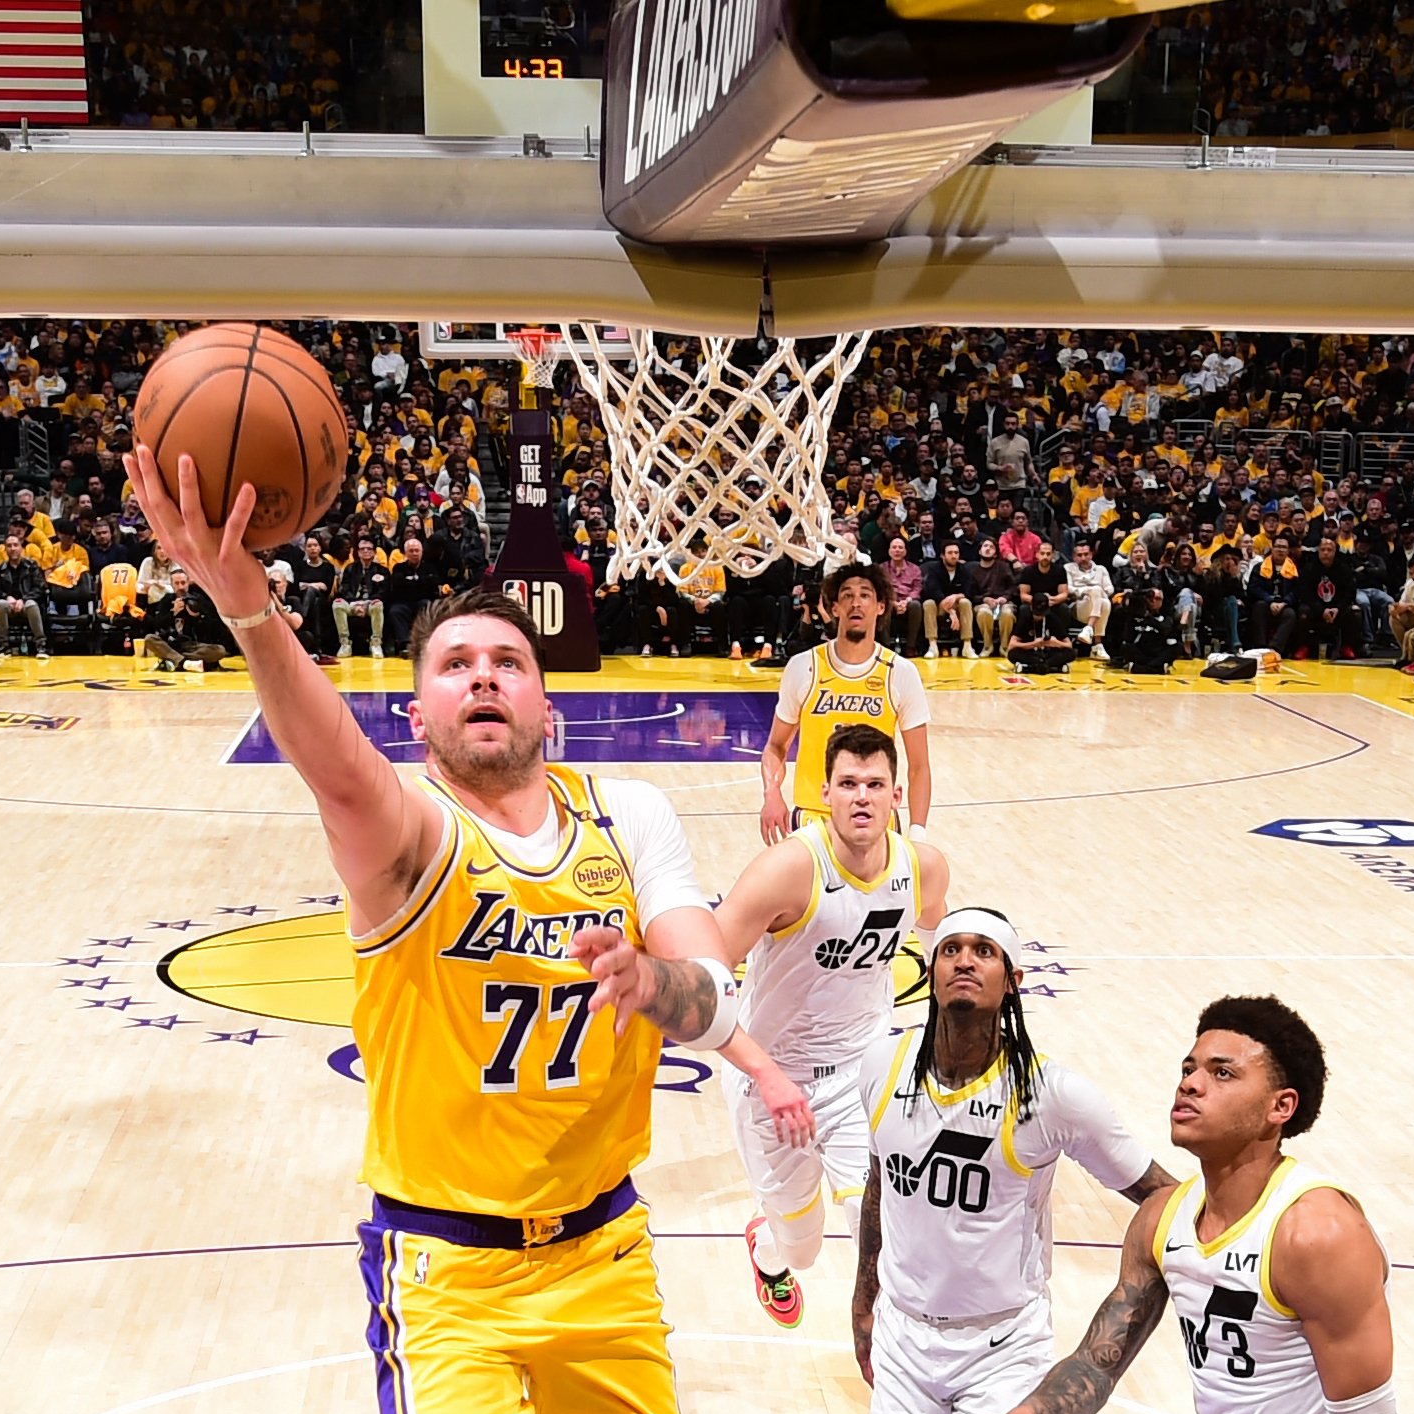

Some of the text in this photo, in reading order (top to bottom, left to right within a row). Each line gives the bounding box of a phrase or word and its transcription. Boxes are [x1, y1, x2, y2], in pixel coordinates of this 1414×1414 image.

[519, 444, 541, 464] GET
[520, 464, 542, 483] THE
[525, 484, 547, 507] App
[111, 569, 129, 585] 77
[532, 581, 564, 636] iD
[810, 688, 884, 717] LAKERS
[576, 866, 621, 883] bibigo
[891, 877, 911, 892] LVT
[852, 930, 901, 970] 24
[480, 979, 600, 1093] 77
[969, 1099, 1003, 1121] LVT
[927, 1156, 991, 1214] 00
[1224, 1251, 1260, 1273] LVT
[1221, 1321, 1256, 1379] 3
